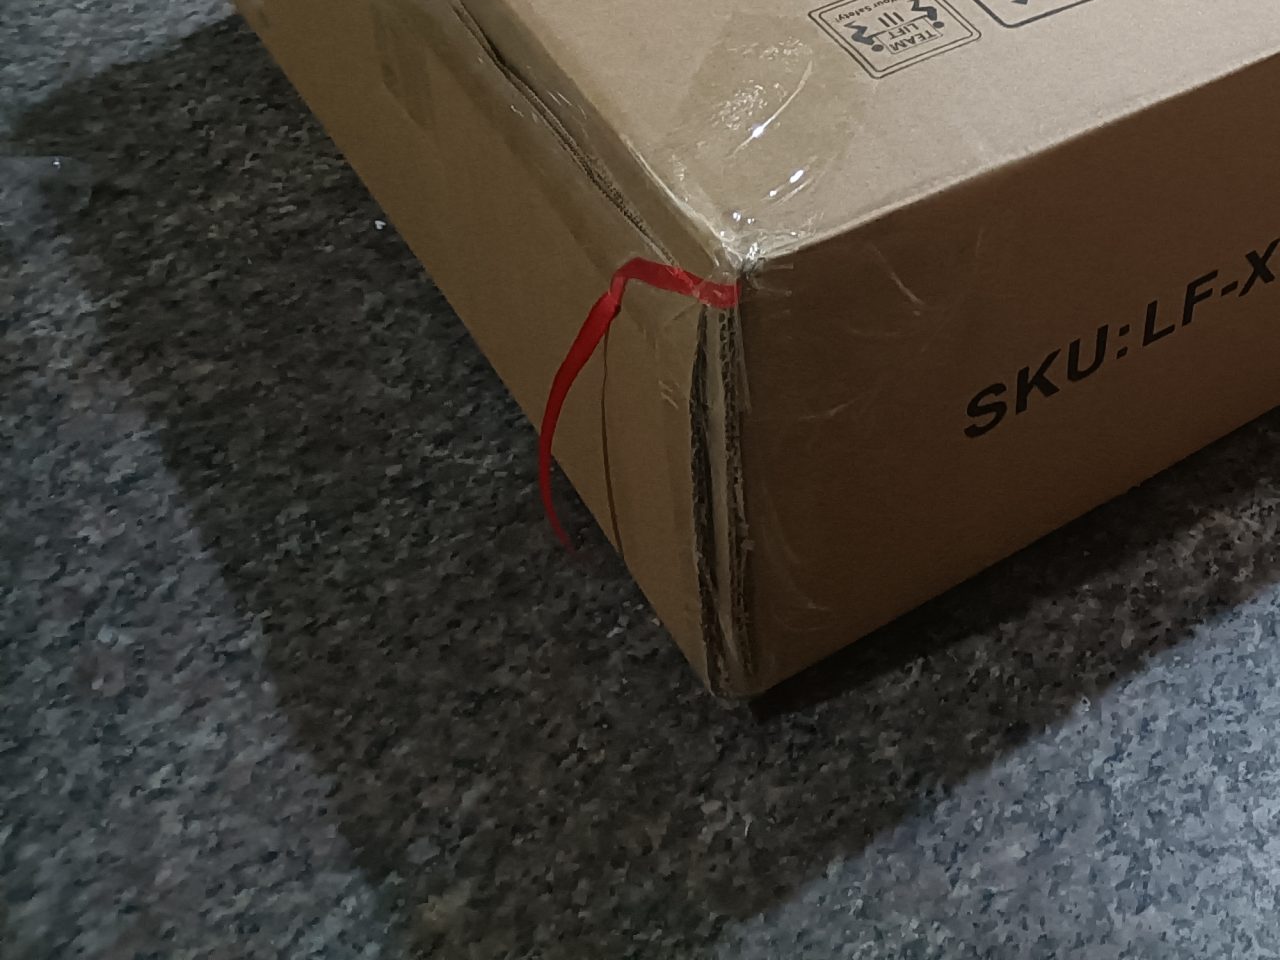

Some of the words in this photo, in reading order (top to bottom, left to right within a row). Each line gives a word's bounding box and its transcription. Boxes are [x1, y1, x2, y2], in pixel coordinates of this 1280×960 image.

[835, 5, 873, 23] Safety!
[887, 22, 919, 40] LIFT
[889, 29, 937, 52] TEAM
